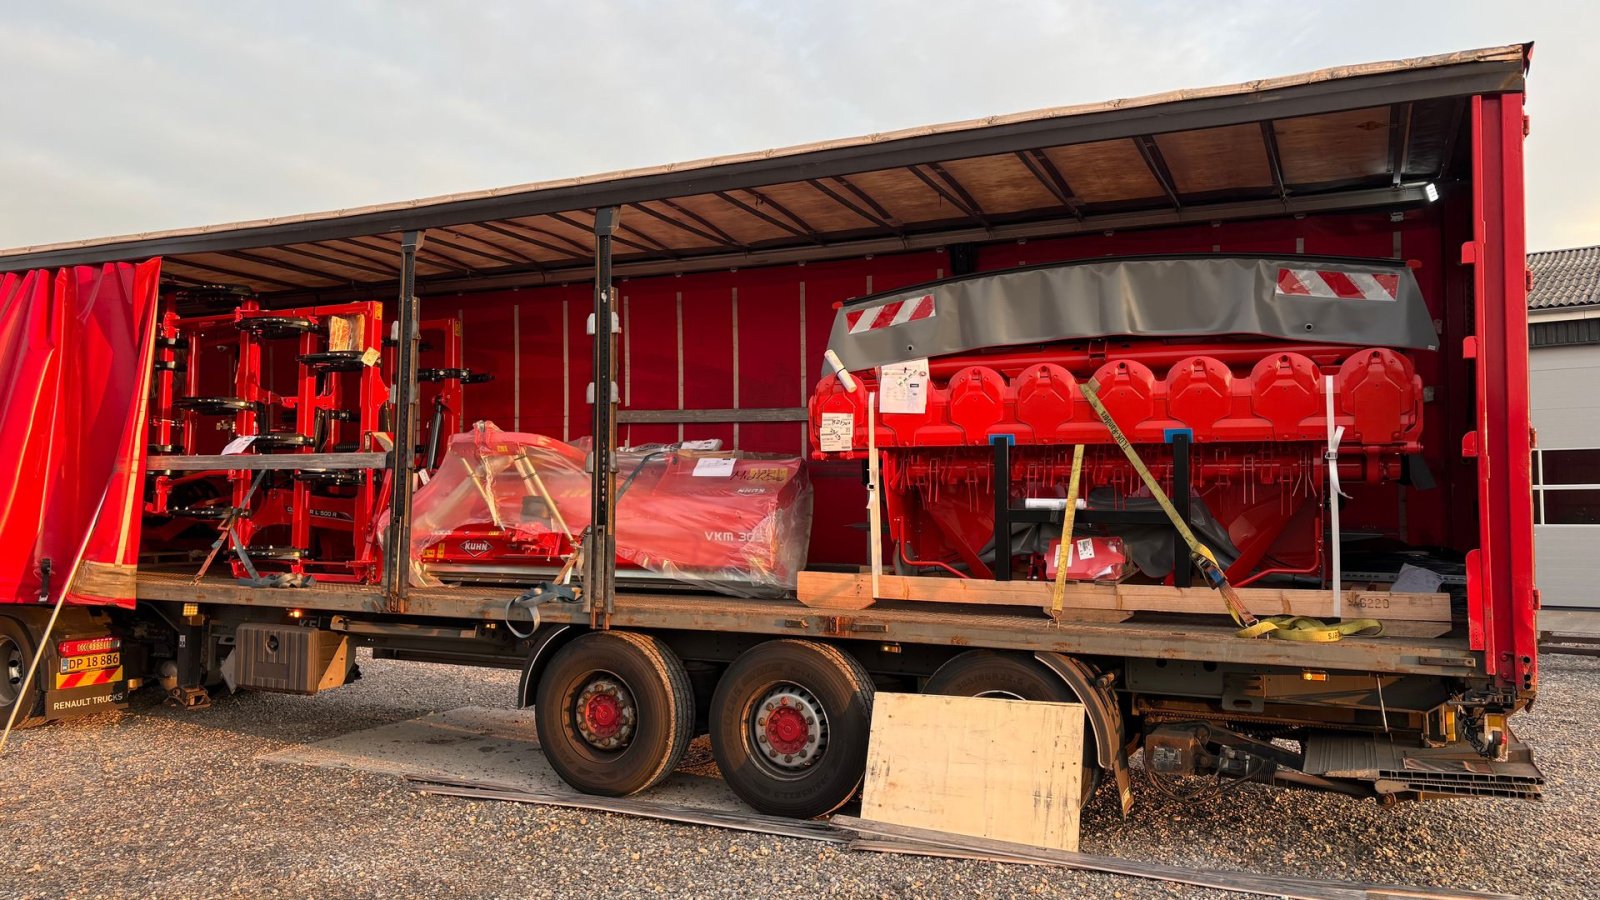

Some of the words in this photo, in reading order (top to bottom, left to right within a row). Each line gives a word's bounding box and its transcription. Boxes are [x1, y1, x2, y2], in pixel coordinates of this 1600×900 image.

[704, 532, 734, 541] VKM
[464, 542, 488, 551] KUHN
[69, 659, 82, 669] DP
[86, 656, 98, 667] 18
[100, 654, 118, 665] 886
[53, 698, 91, 710] RENAULT
[92, 693, 123, 704] TRUCKS
